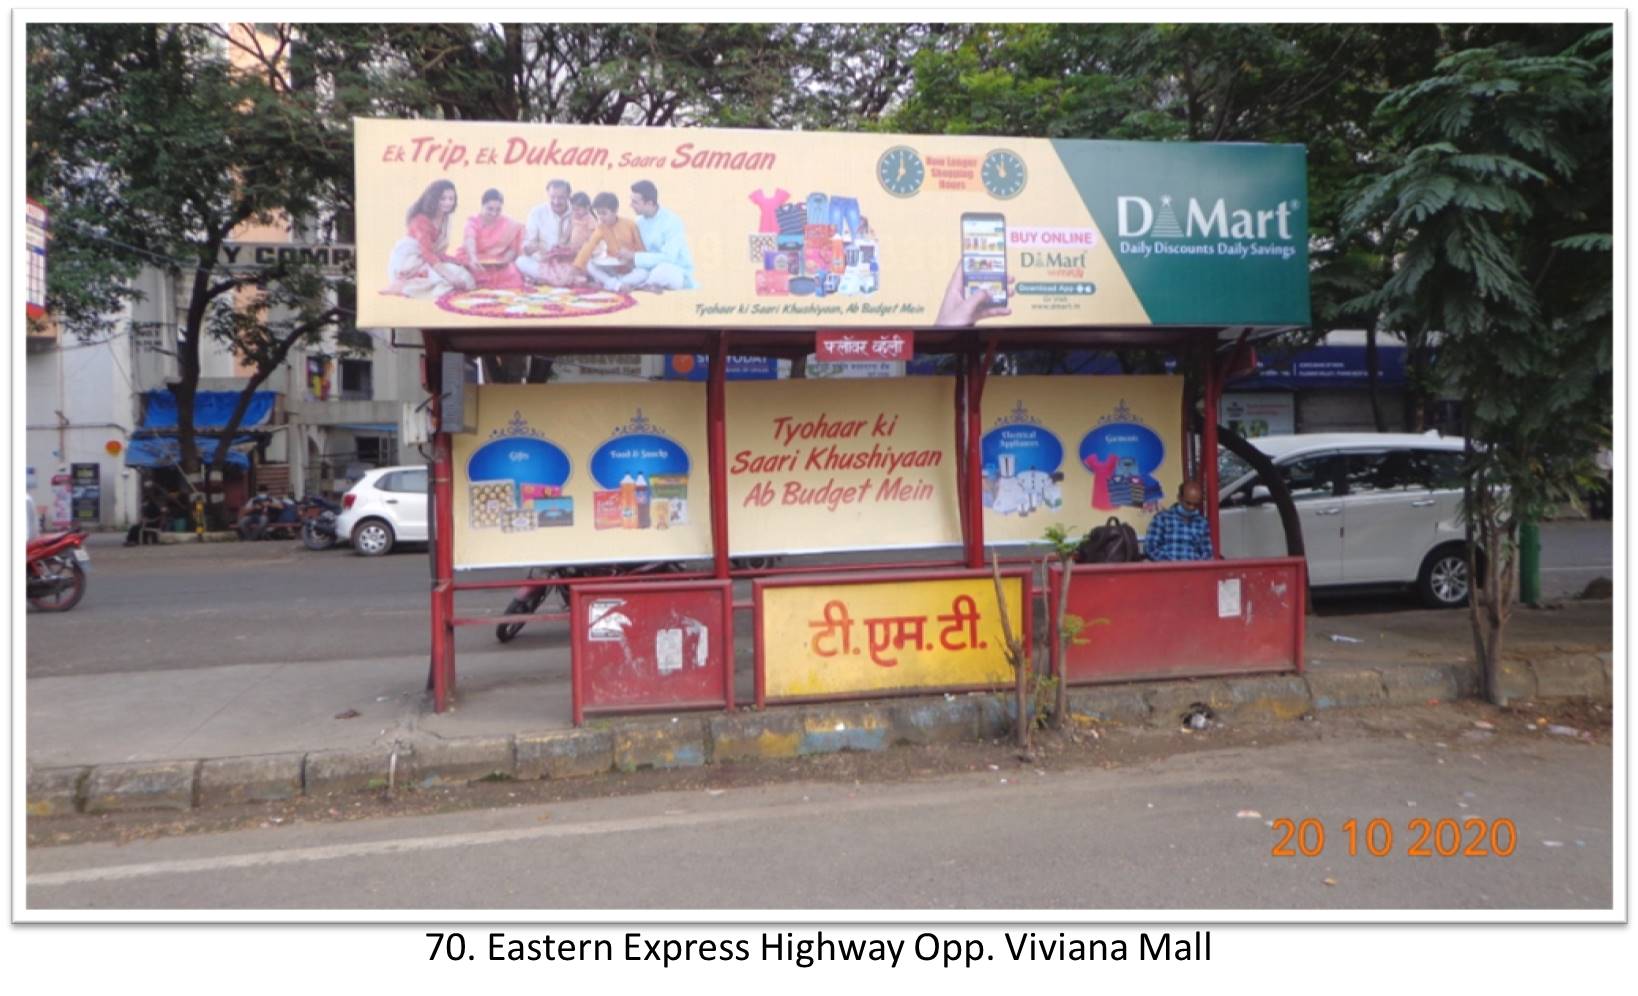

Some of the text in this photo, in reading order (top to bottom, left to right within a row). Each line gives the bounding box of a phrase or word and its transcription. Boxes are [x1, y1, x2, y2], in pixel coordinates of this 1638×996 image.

[382, 136, 776, 170] Ek Trip, Ek Dukaan, Saara Samaan
[1010, 231, 1093, 244] BUY ONLINE
[1120, 241, 1296, 260] Daily Discounts Daily Savings
[695, 302, 736, 317] Tyohaar
[737, 302, 749, 314] ki
[751, 303, 780, 315] Saari
[846, 302, 860, 314] Ab
[861, 302, 898, 317] Budget
[899, 303, 926, 314] Mein
[773, 412, 899, 447] Tyohaar ki
[610, 449, 631, 459] Food
[730, 442, 943, 476] Saari Khushiyaan
[743, 476, 934, 512] Ab Budget Mein
